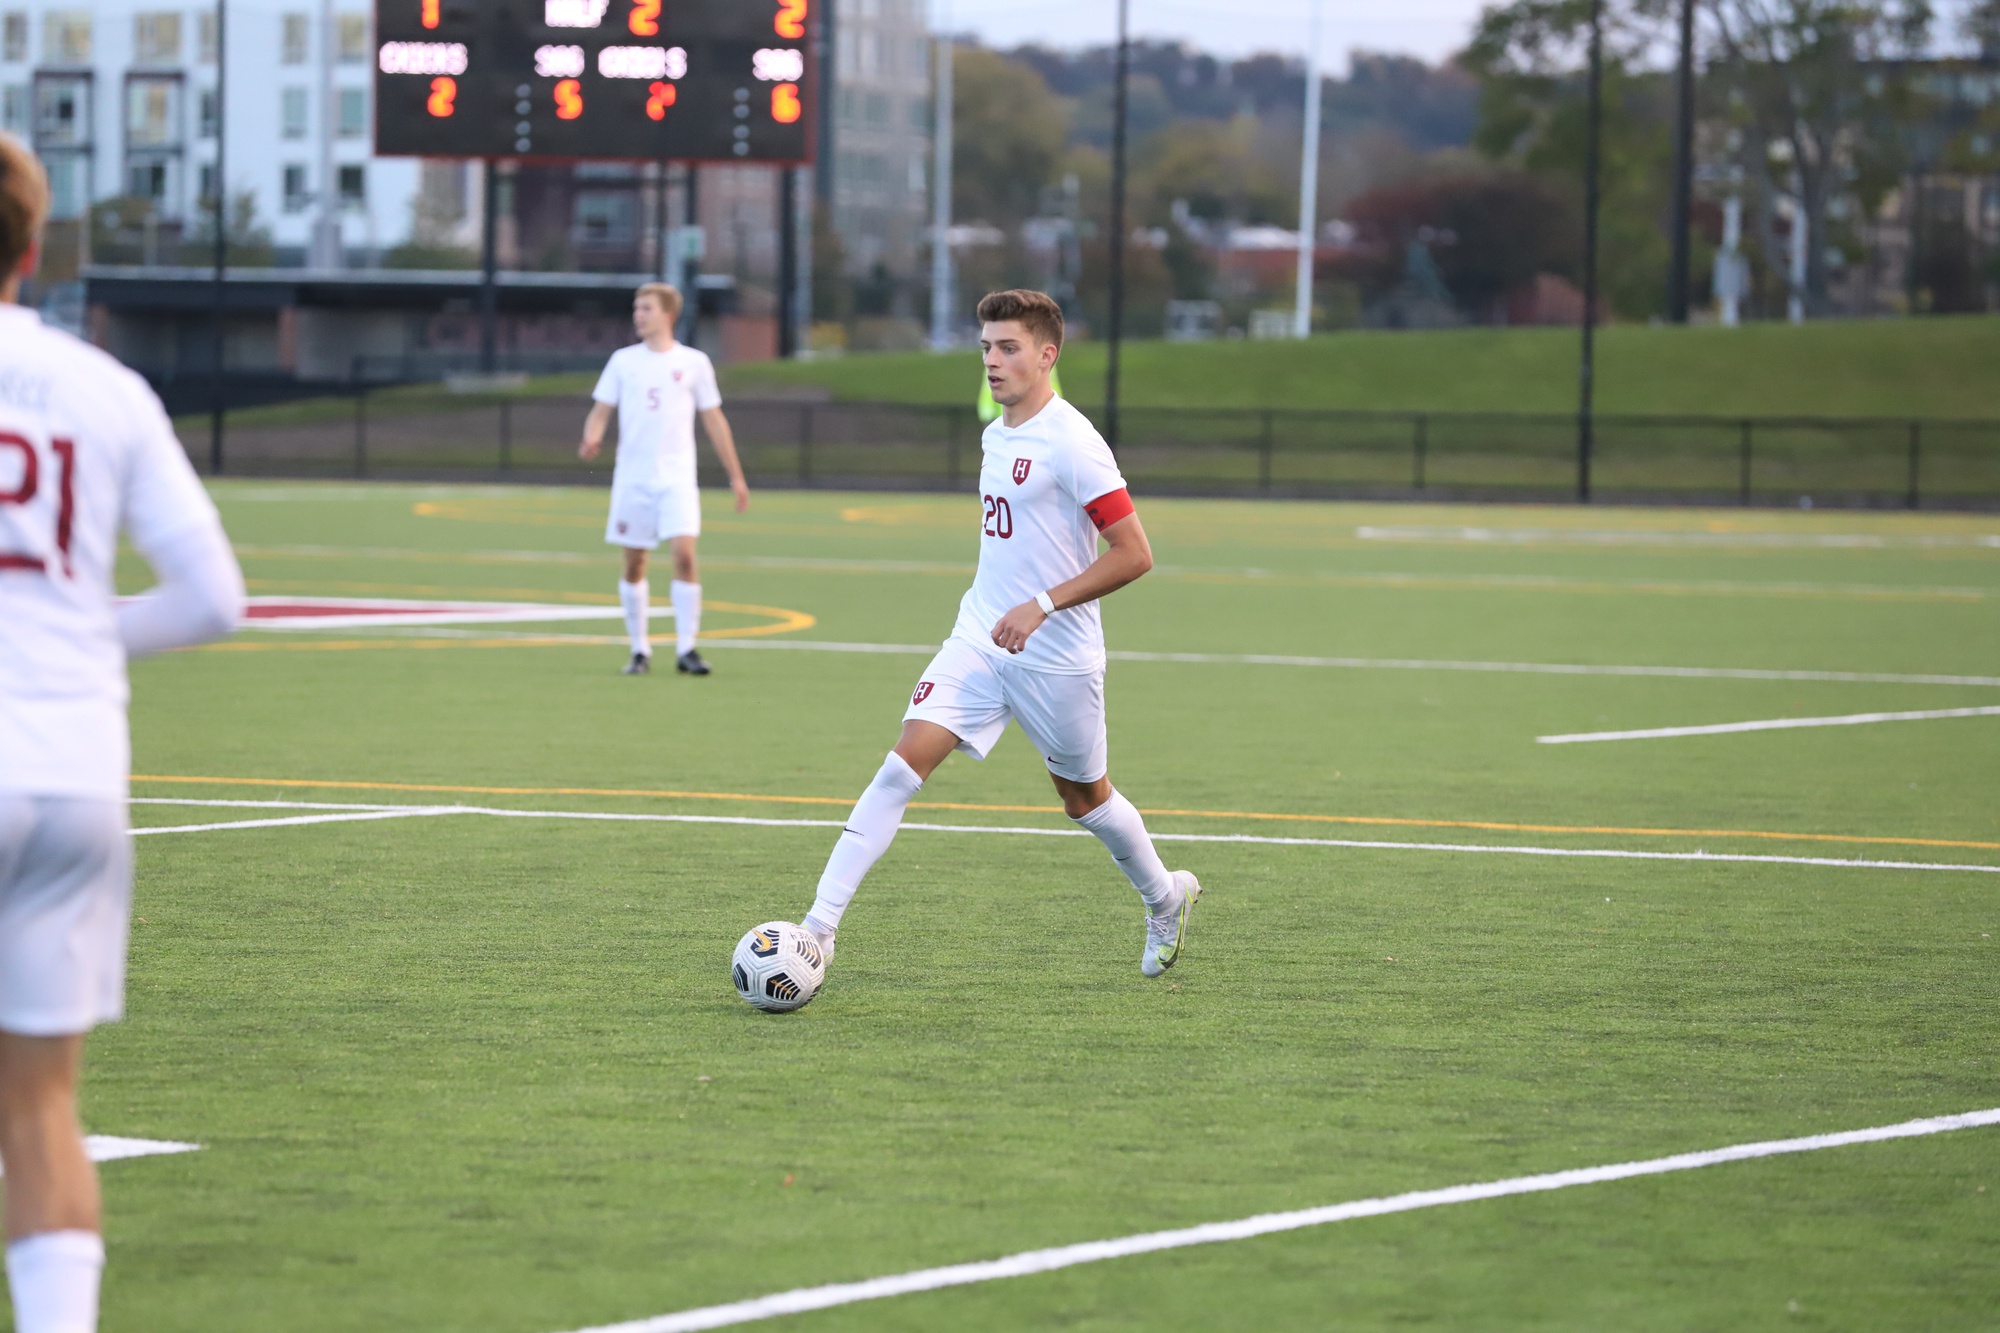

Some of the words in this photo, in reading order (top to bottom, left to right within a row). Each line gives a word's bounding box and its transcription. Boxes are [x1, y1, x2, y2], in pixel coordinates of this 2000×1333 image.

[427, 76, 457, 117] 2
[554, 79, 583, 120] 5
[771, 83, 801, 123] 6
[647, 387, 660, 412] 5
[1014, 459, 1028, 479] H
[983, 494, 1013, 540] 20
[914, 683, 930, 699] H
